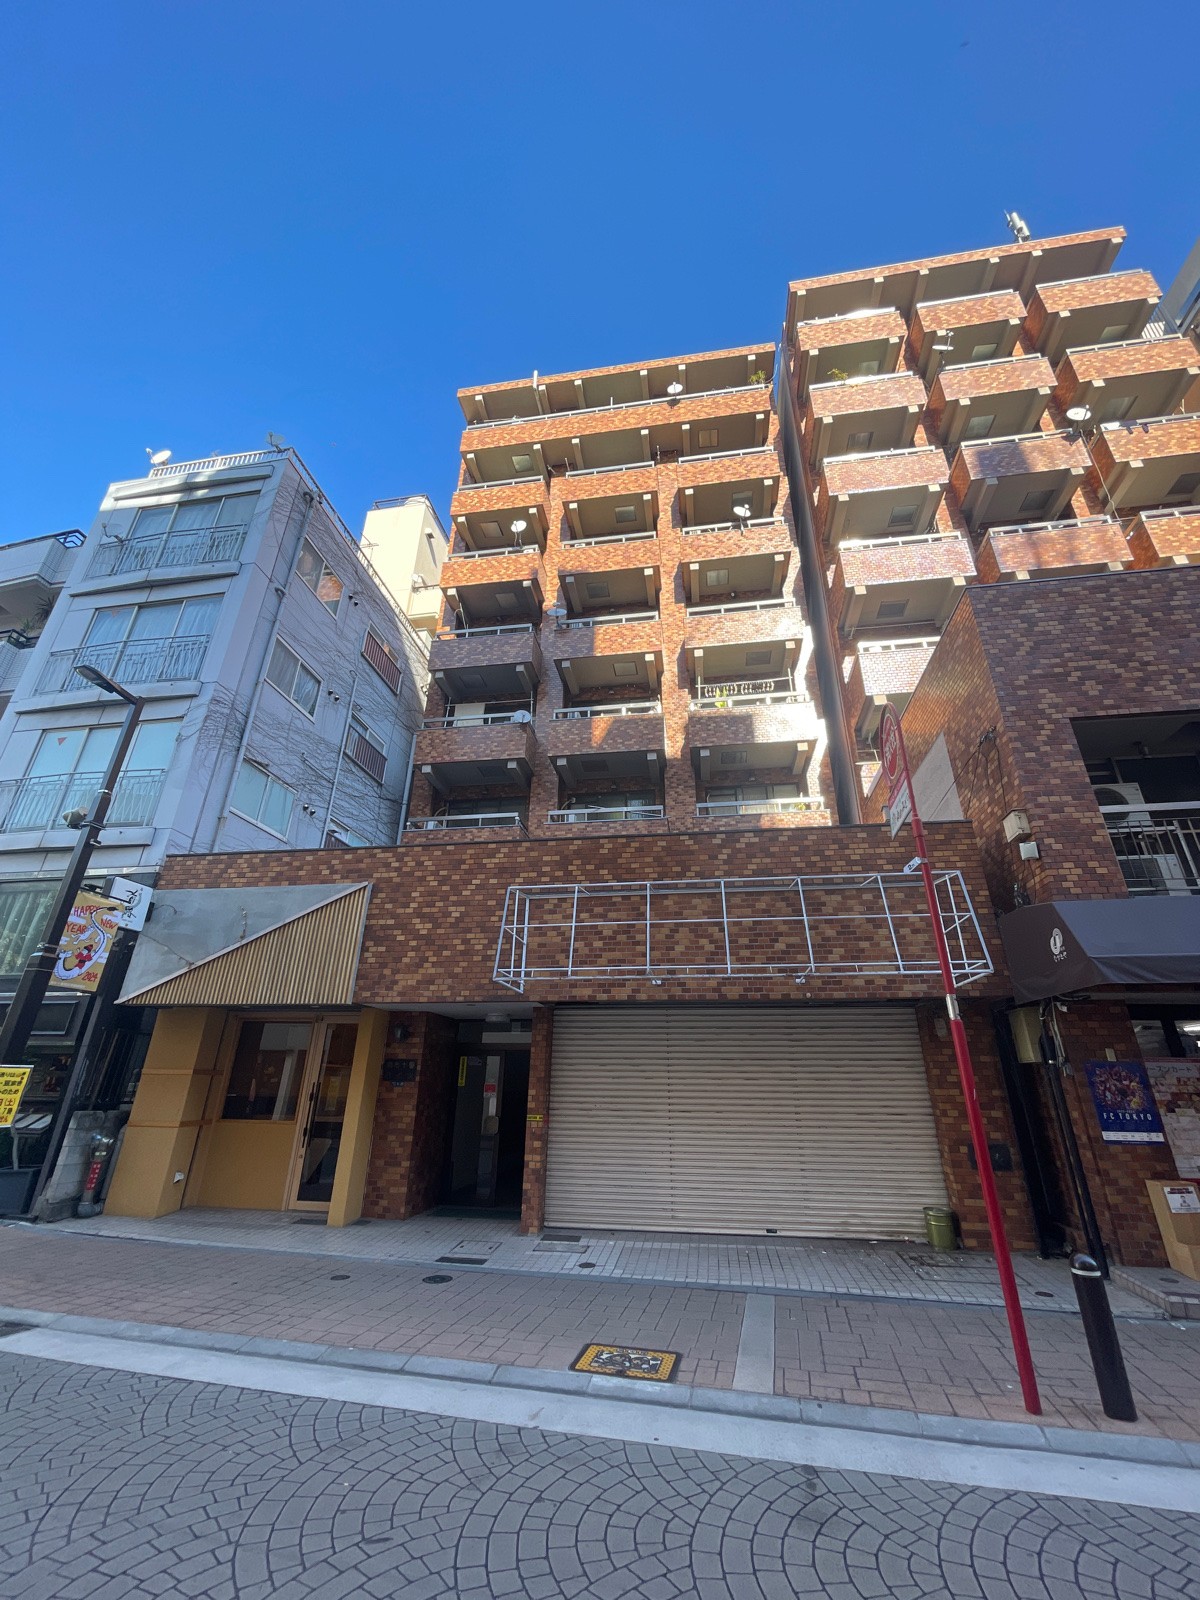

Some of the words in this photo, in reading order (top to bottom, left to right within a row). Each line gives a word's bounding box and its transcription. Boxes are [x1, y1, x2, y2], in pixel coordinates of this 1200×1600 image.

[73, 904, 101, 917] HAPPY
[65, 922, 87, 934] YEAR
[100, 917, 118, 929] NEW
[82, 971, 98, 982] 2024
[1103, 1112, 1115, 1120] FC
[1118, 1112, 1152, 1121] TOKYO
